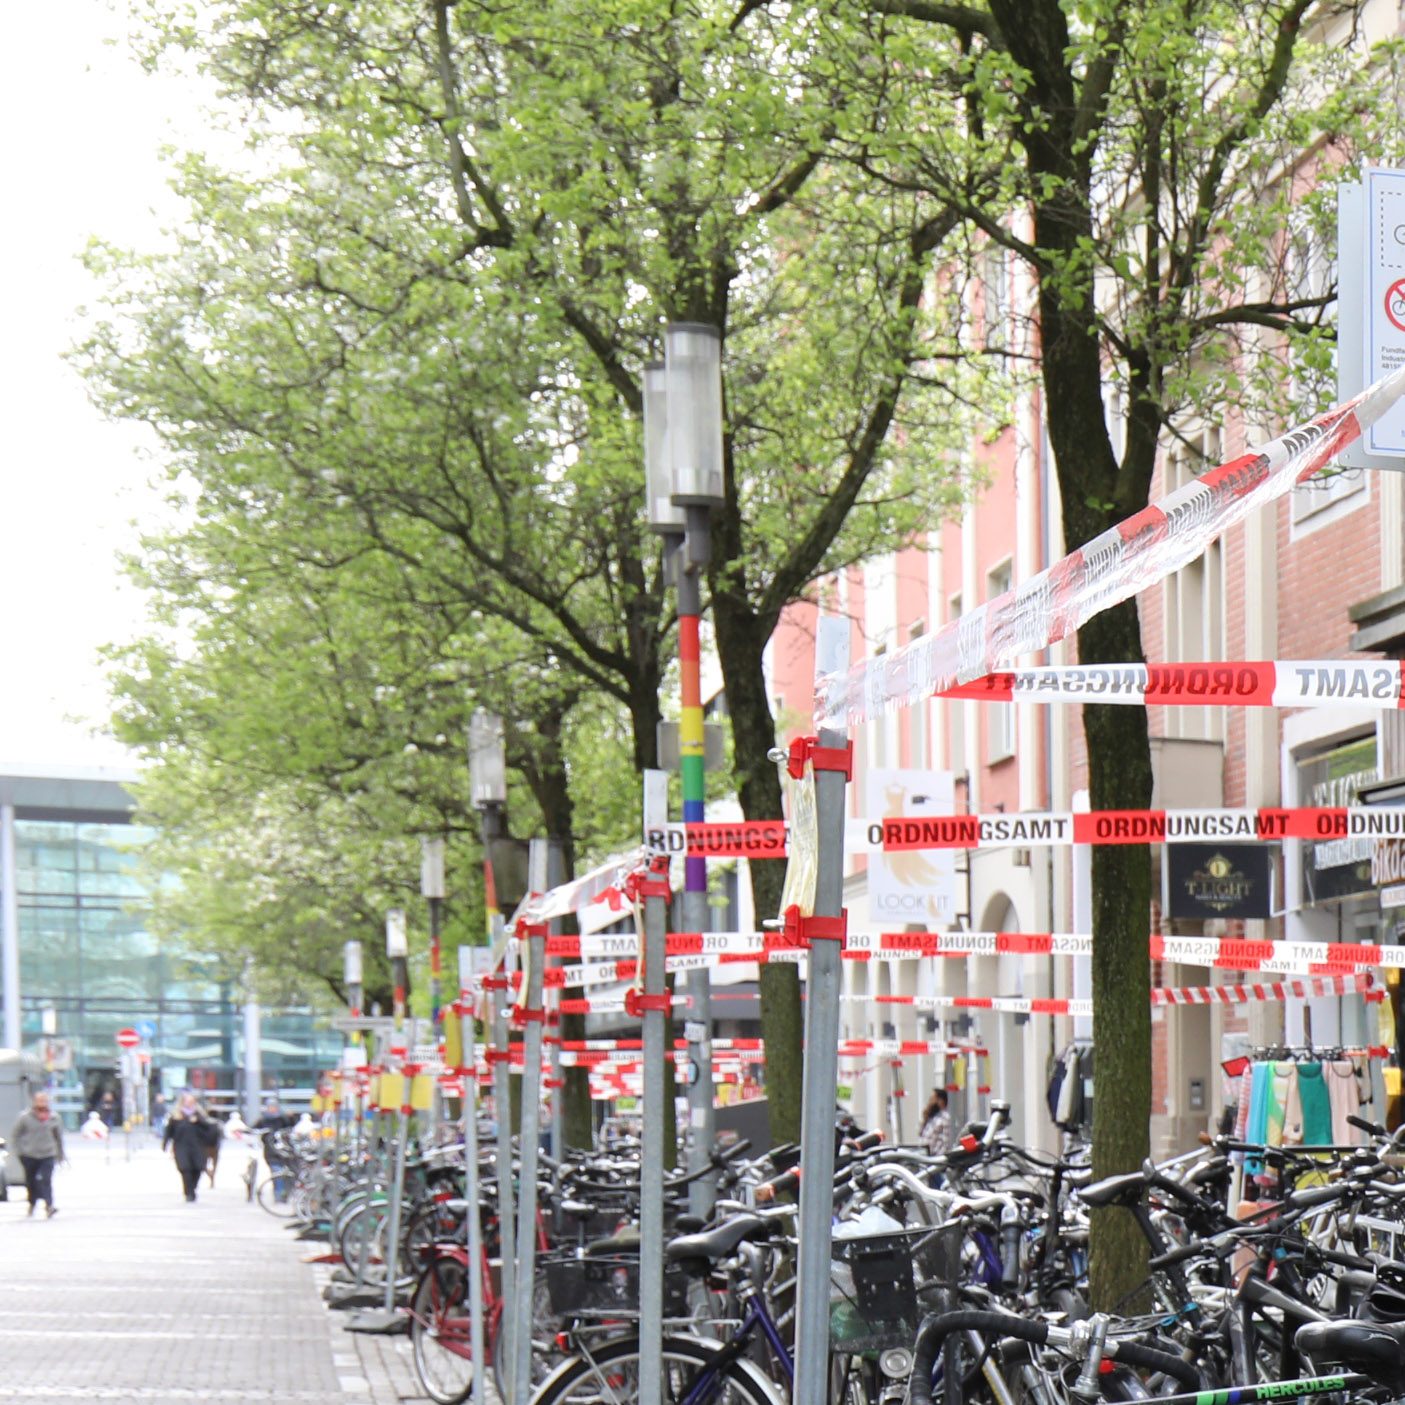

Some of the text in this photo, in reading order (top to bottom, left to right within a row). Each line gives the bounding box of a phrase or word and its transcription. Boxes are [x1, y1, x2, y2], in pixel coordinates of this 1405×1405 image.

[648, 827, 792, 852] RDNUNGSA
[868, 818, 1068, 844] ORDNUNGSAMT
[1096, 814, 1290, 840] ORDNUNGSAMT
[877, 893, 925, 910] LOOK
[1256, 1377, 1346, 1400] HERCULES
